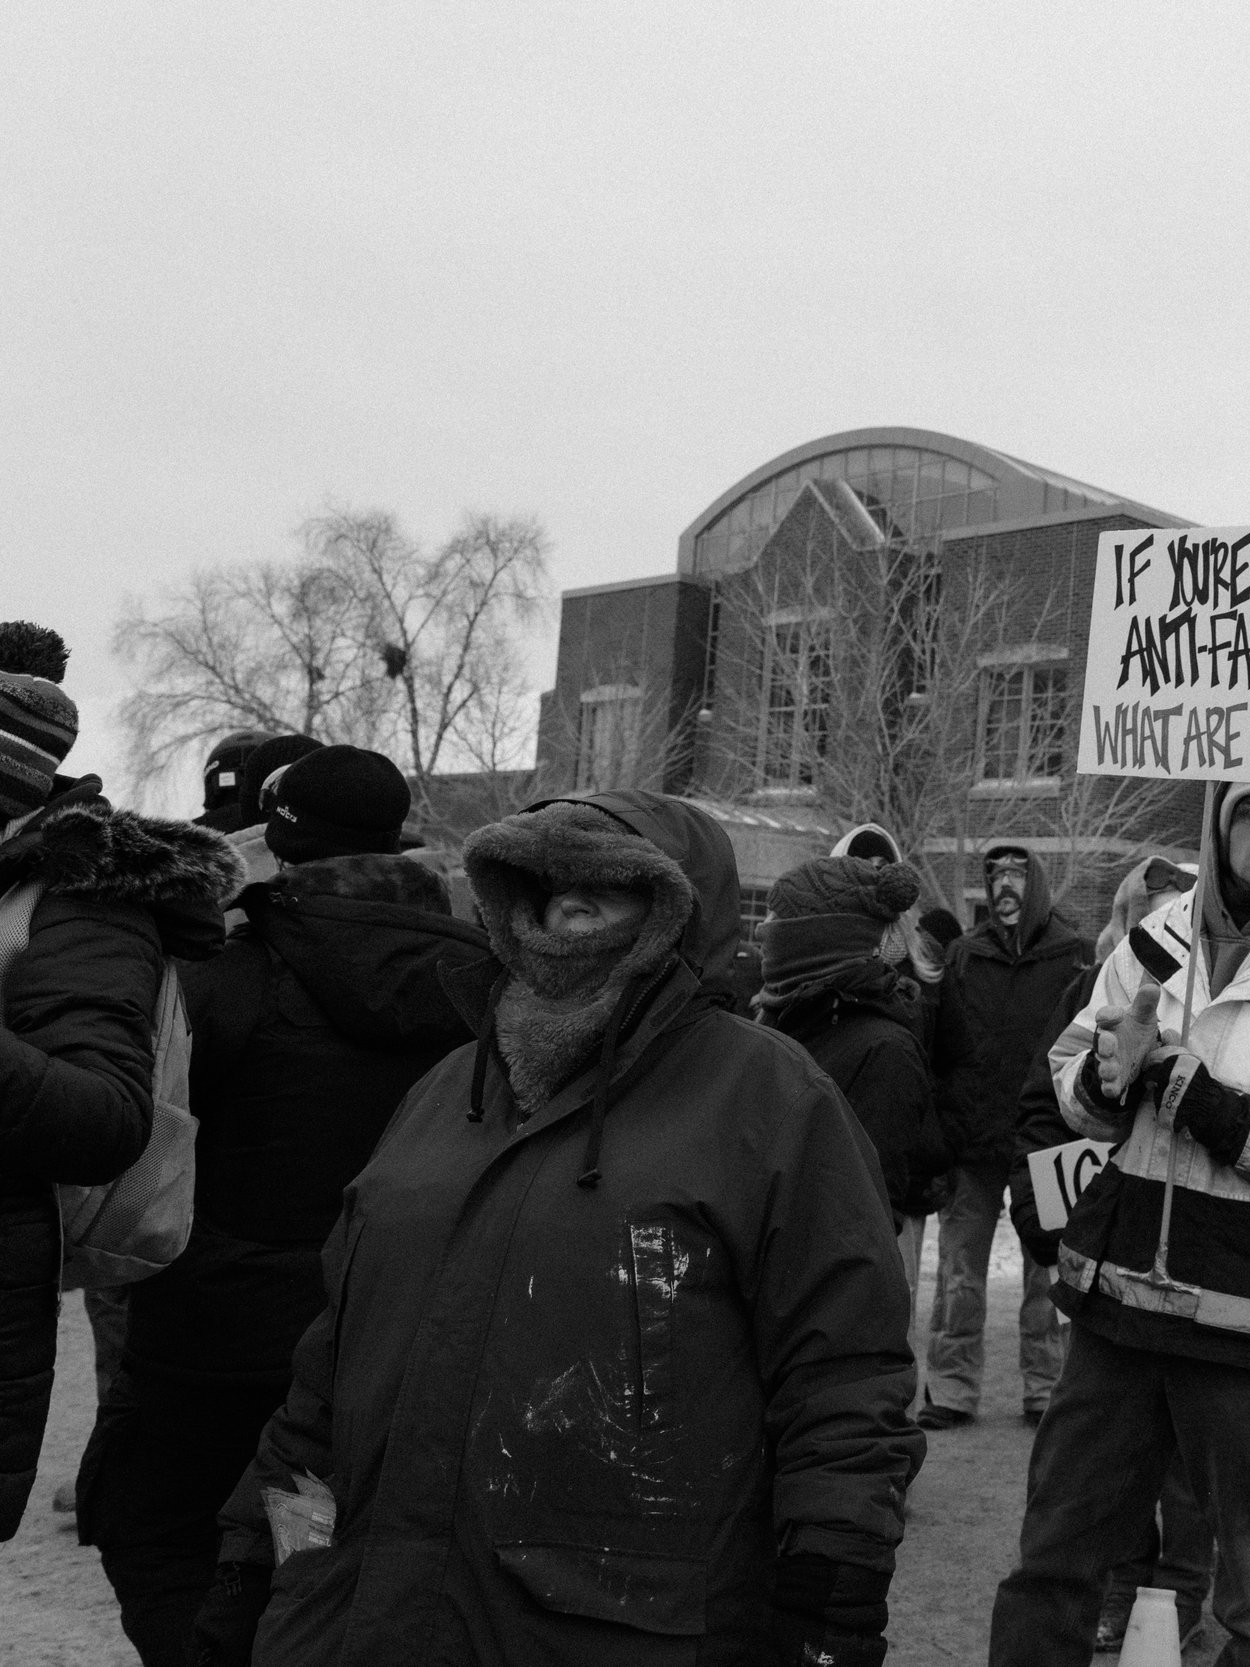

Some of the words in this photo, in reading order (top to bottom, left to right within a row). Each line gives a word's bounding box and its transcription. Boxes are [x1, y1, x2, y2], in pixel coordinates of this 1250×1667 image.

[1114, 533, 1154, 610] IF
[1092, 700, 1184, 775] WHAT
[1180, 701, 1249, 772] ARE
[1165, 1074, 1186, 1110] KINCO
